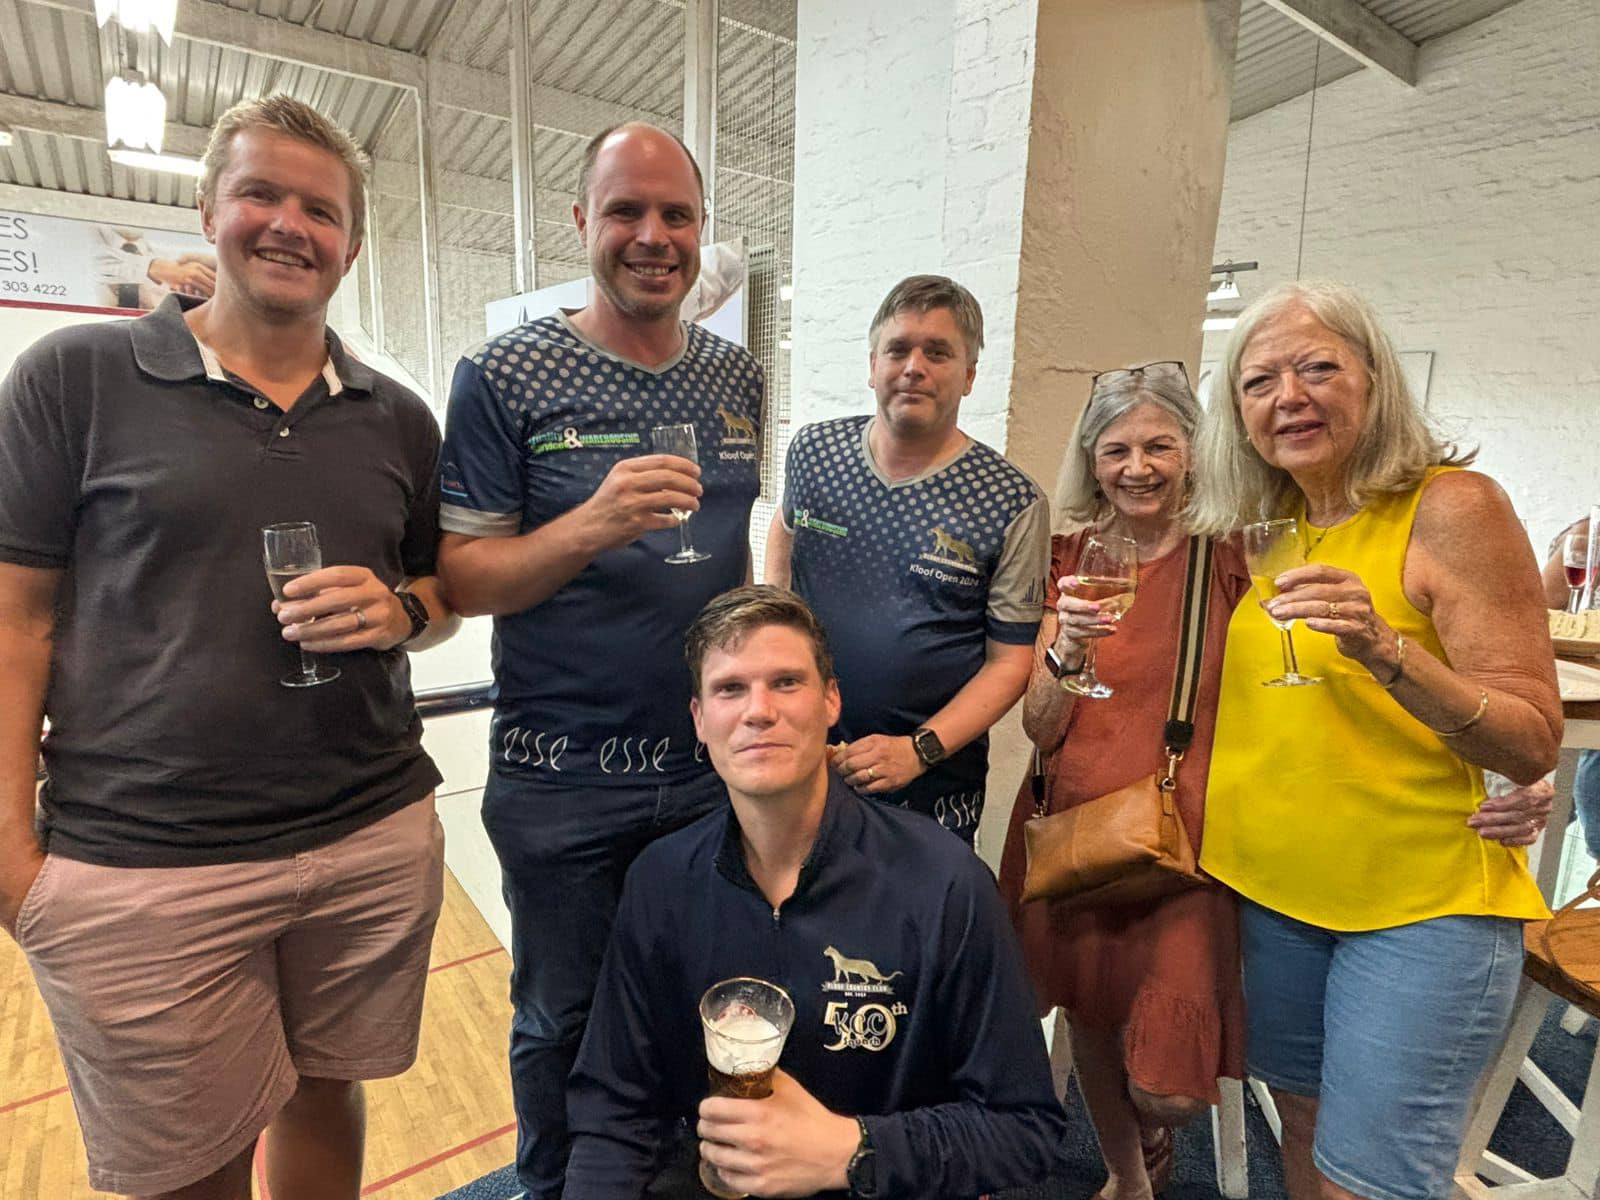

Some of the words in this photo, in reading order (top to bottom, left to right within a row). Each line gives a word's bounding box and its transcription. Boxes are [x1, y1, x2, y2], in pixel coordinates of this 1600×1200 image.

[2, 280, 29, 293] 303
[33, 283, 67, 296] 4222
[909, 563, 934, 577] Kloof
[935, 570, 958, 583] Open
[504, 726, 568, 771] esse
[600, 736, 670, 773] esse
